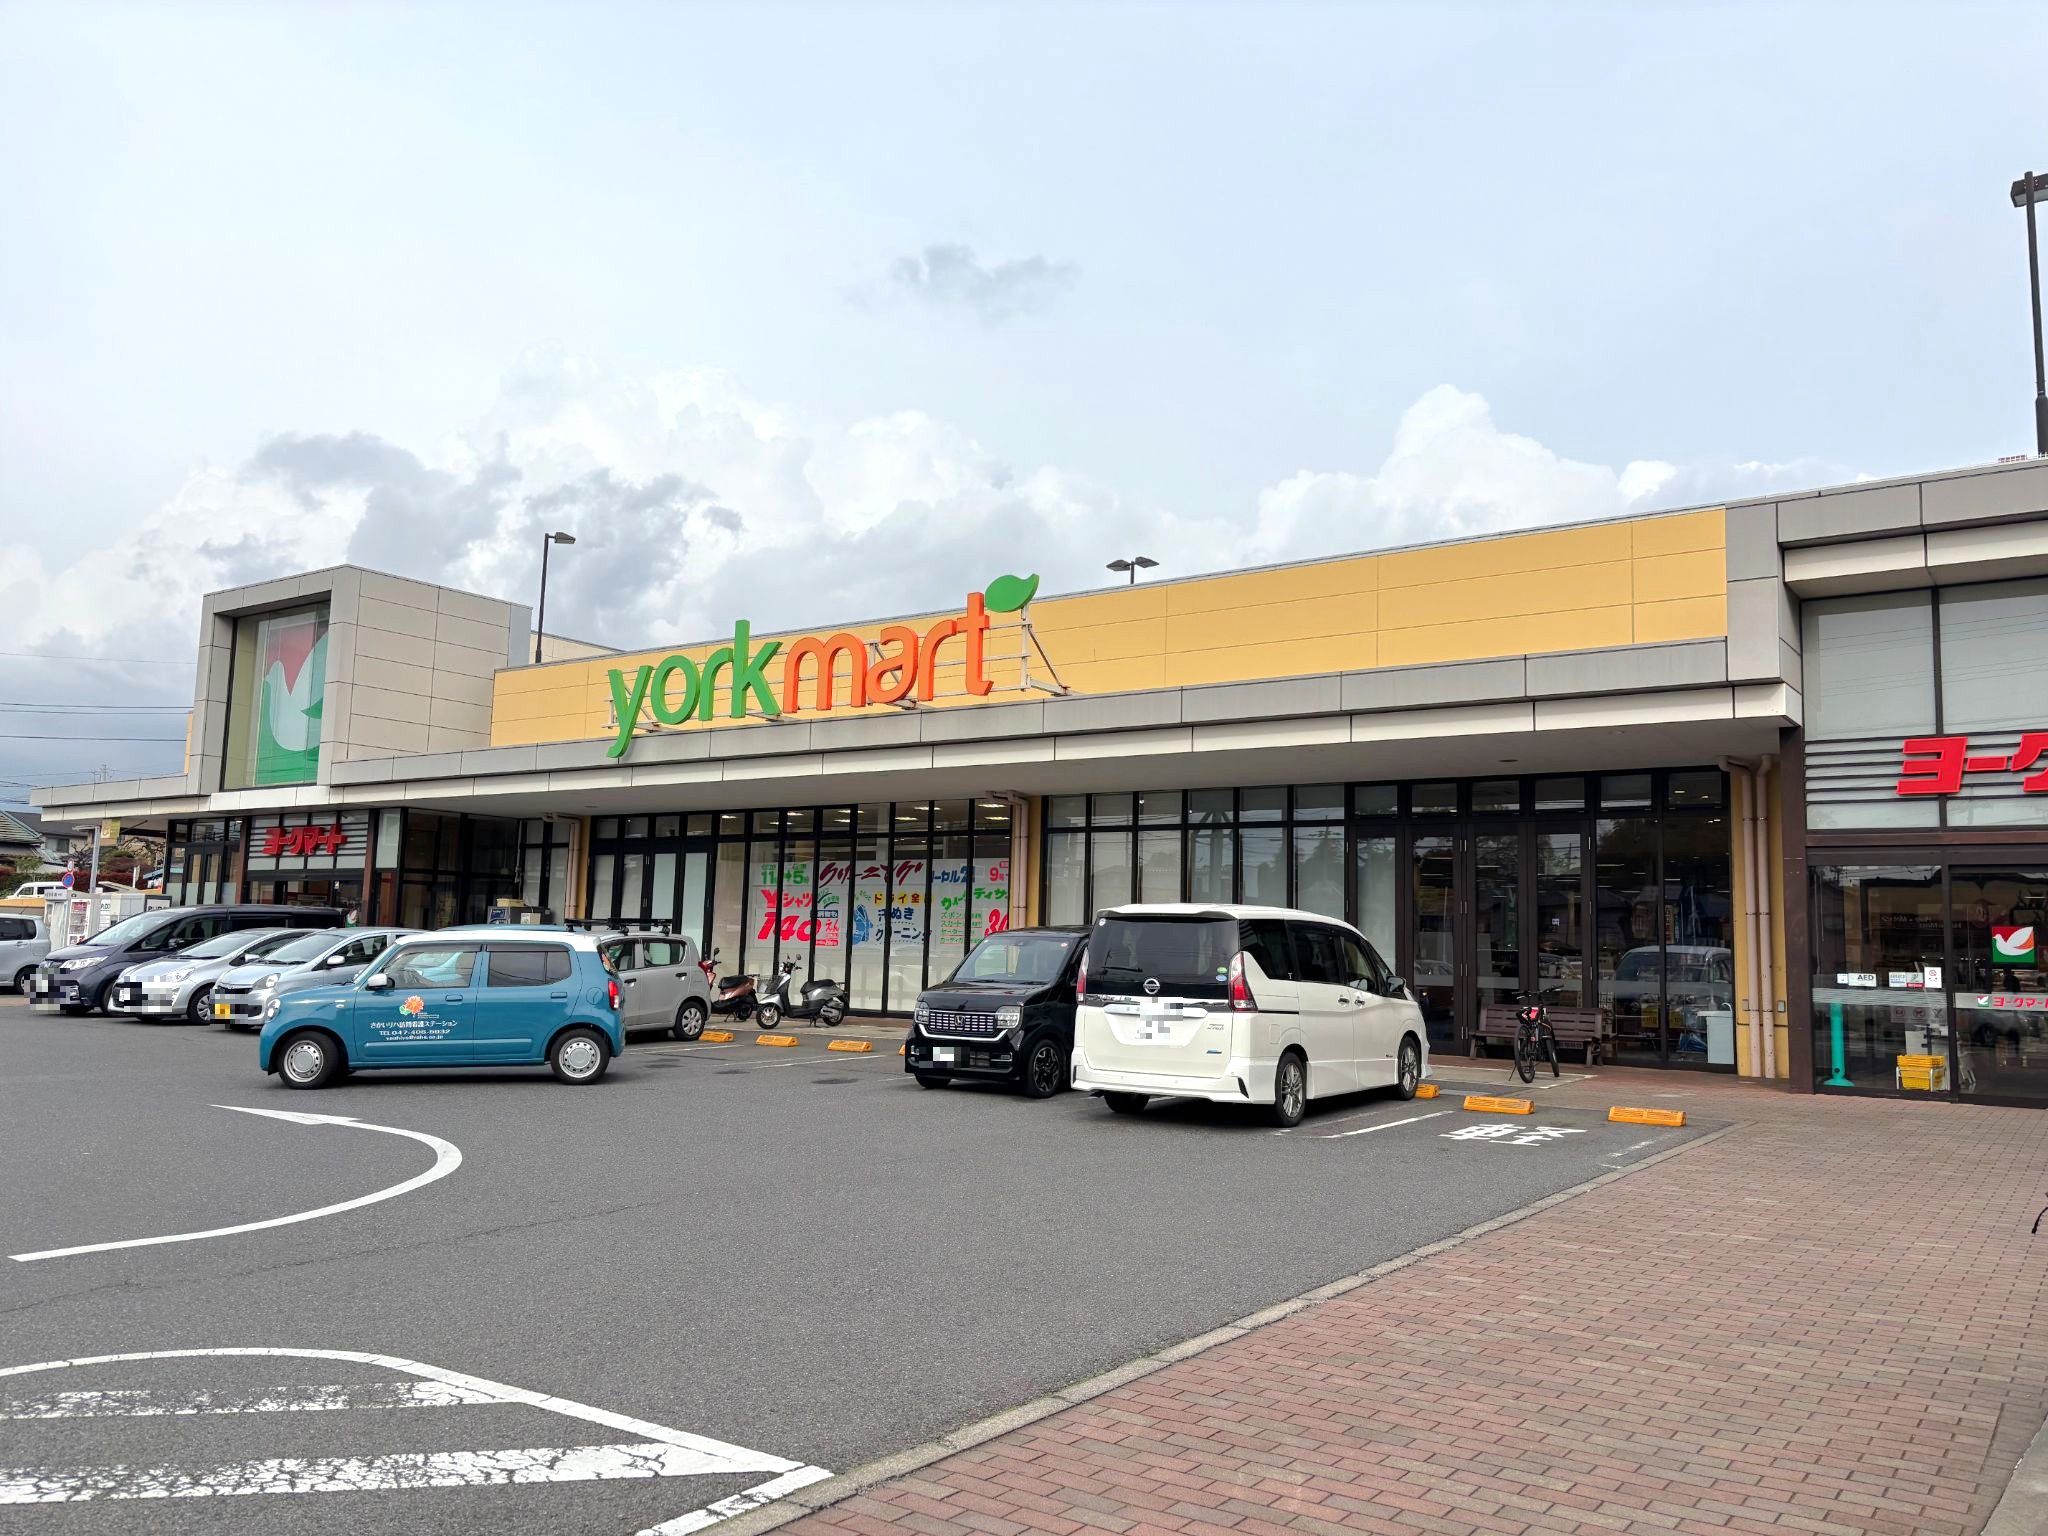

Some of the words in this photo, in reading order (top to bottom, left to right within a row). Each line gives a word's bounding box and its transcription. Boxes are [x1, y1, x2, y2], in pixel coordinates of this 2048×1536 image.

[607, 592, 994, 759] yorkmart
[262, 823, 348, 856] ヨークマート
